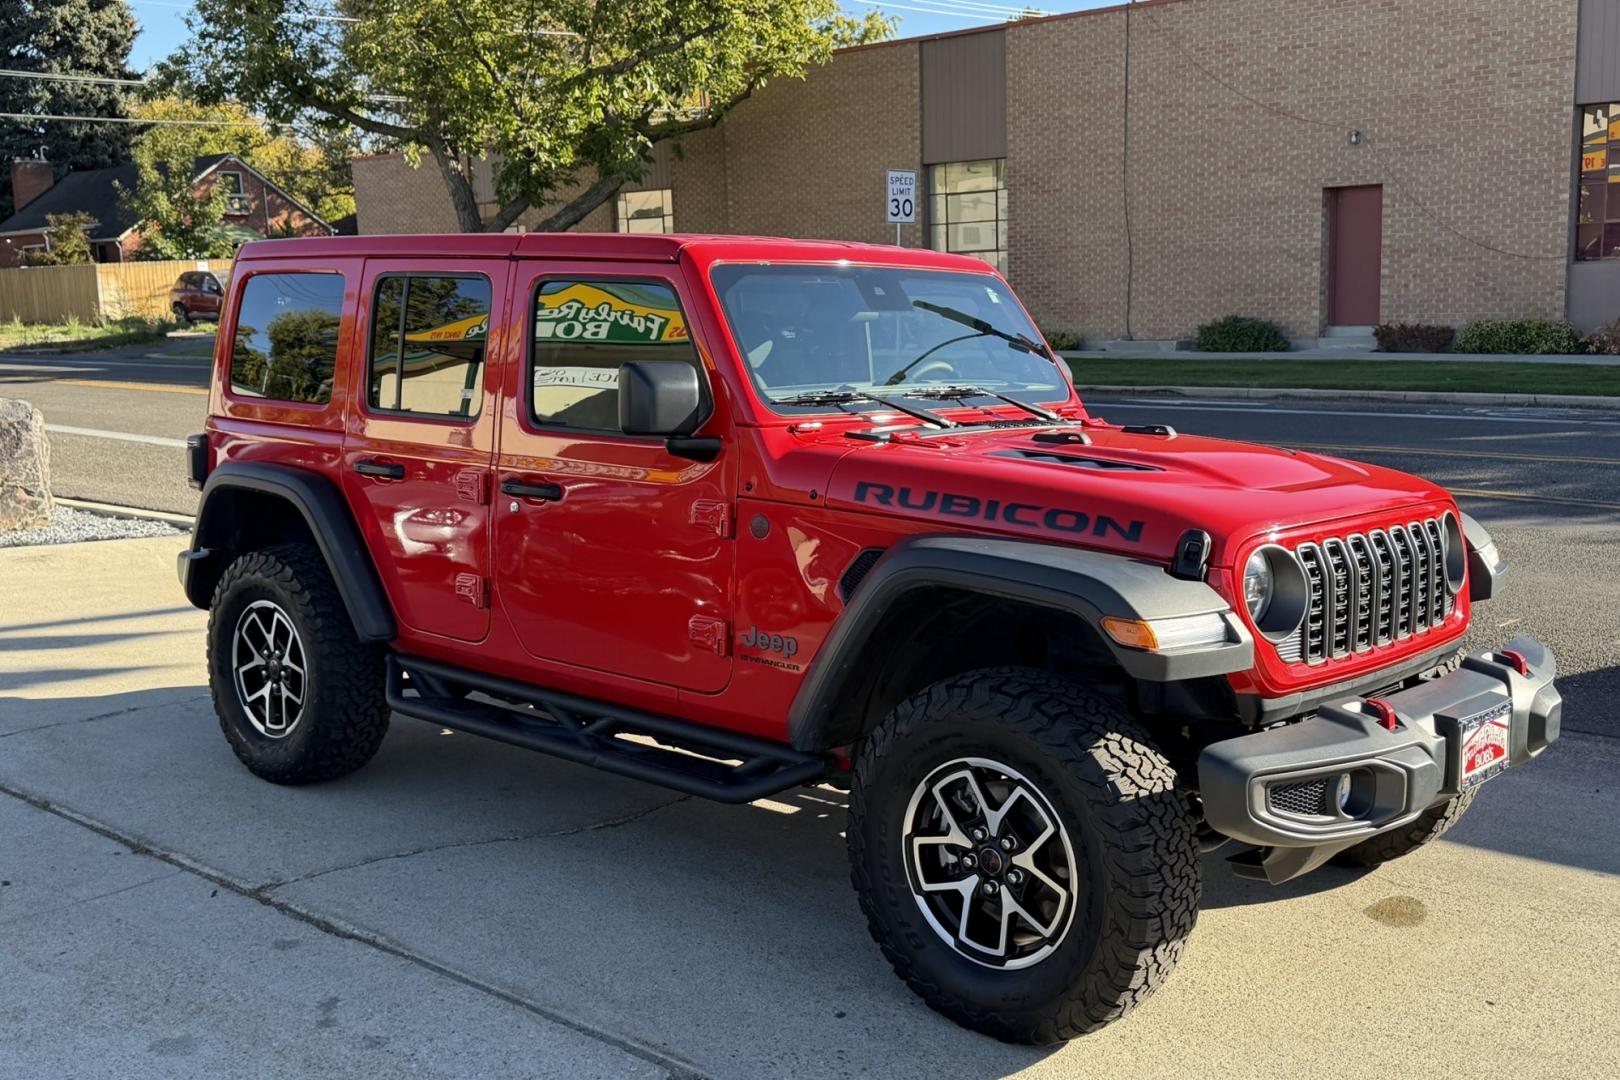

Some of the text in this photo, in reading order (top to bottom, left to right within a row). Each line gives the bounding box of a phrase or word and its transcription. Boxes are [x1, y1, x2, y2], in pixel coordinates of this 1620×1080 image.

[890, 176, 914, 186] SPEED
[892, 187, 911, 196] LIMIT
[890, 198, 913, 217] 30
[853, 481, 1145, 543] RUBICON
[741, 624, 798, 659] Jeep
[749, 655, 800, 671] WRANGLER
